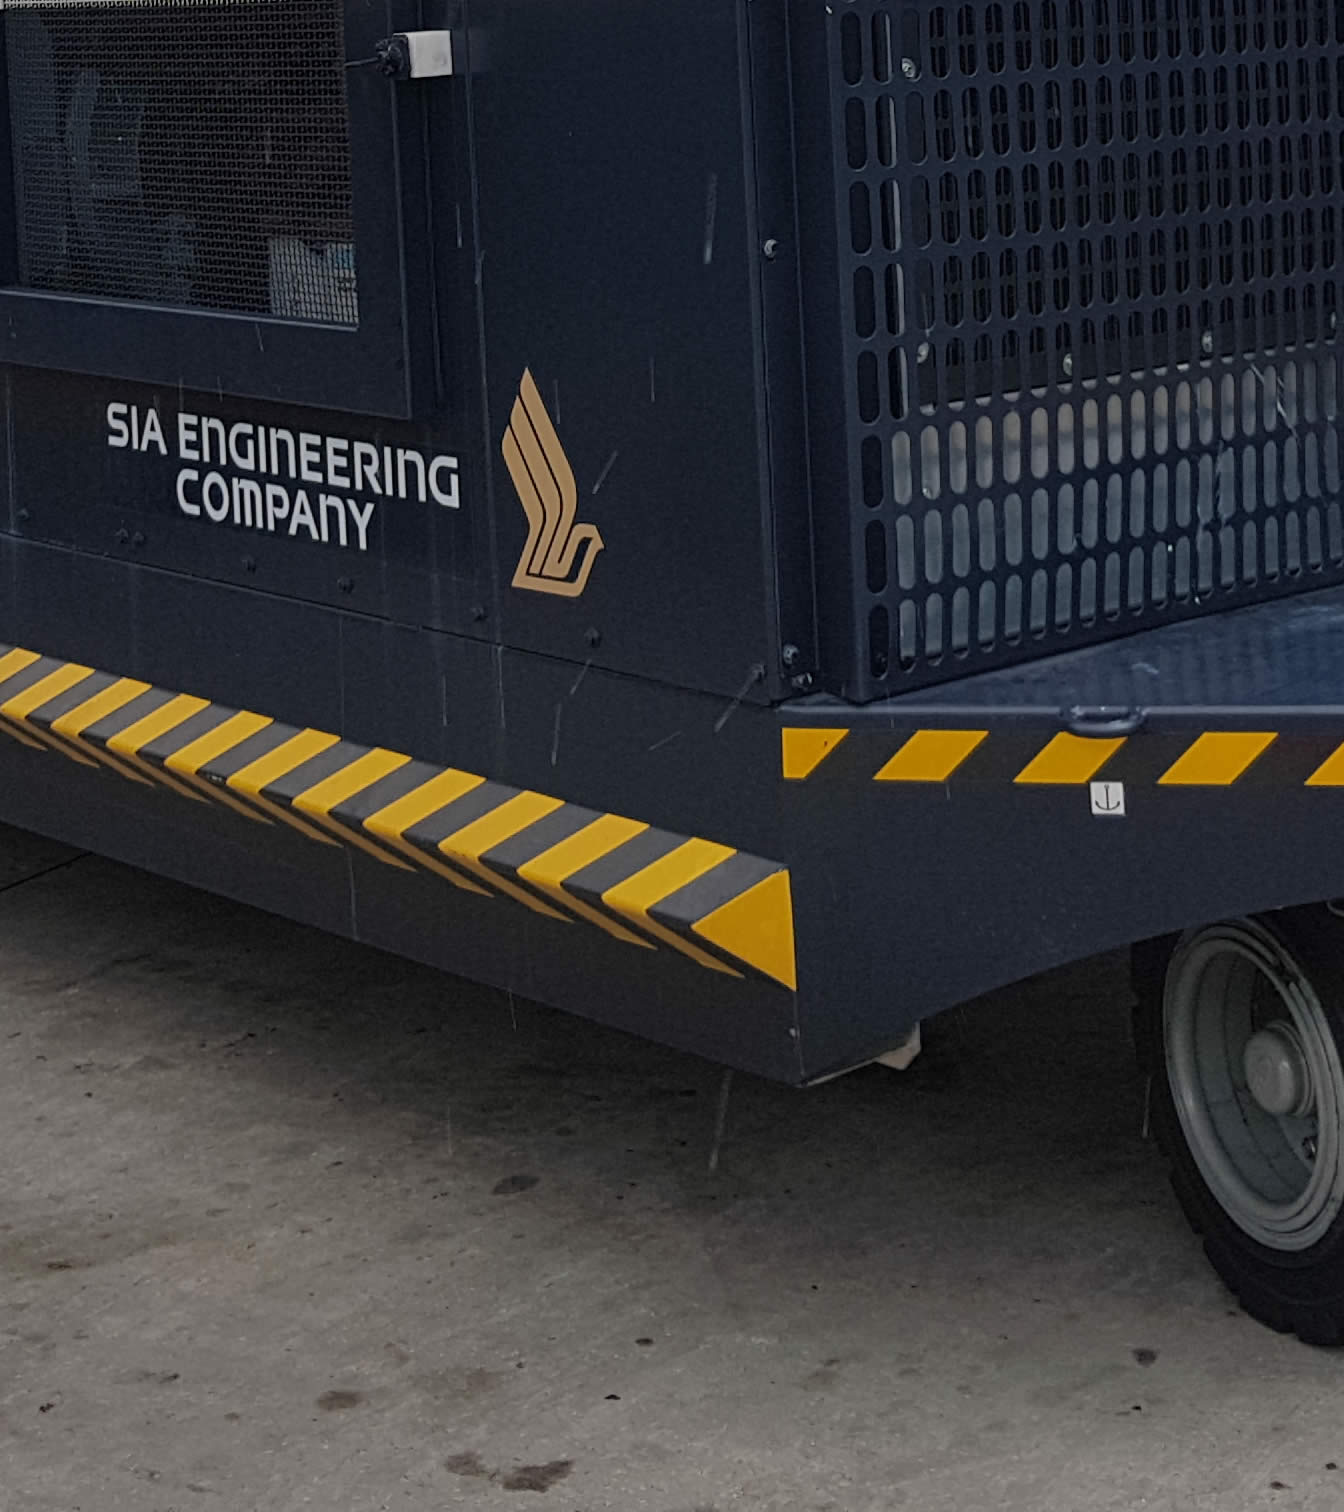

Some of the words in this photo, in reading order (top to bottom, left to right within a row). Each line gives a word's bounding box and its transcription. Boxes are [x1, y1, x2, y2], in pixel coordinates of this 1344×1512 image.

[106, 401, 168, 456] SIA
[177, 411, 461, 509] ENGINEERING
[175, 468, 375, 551] COMPANY
